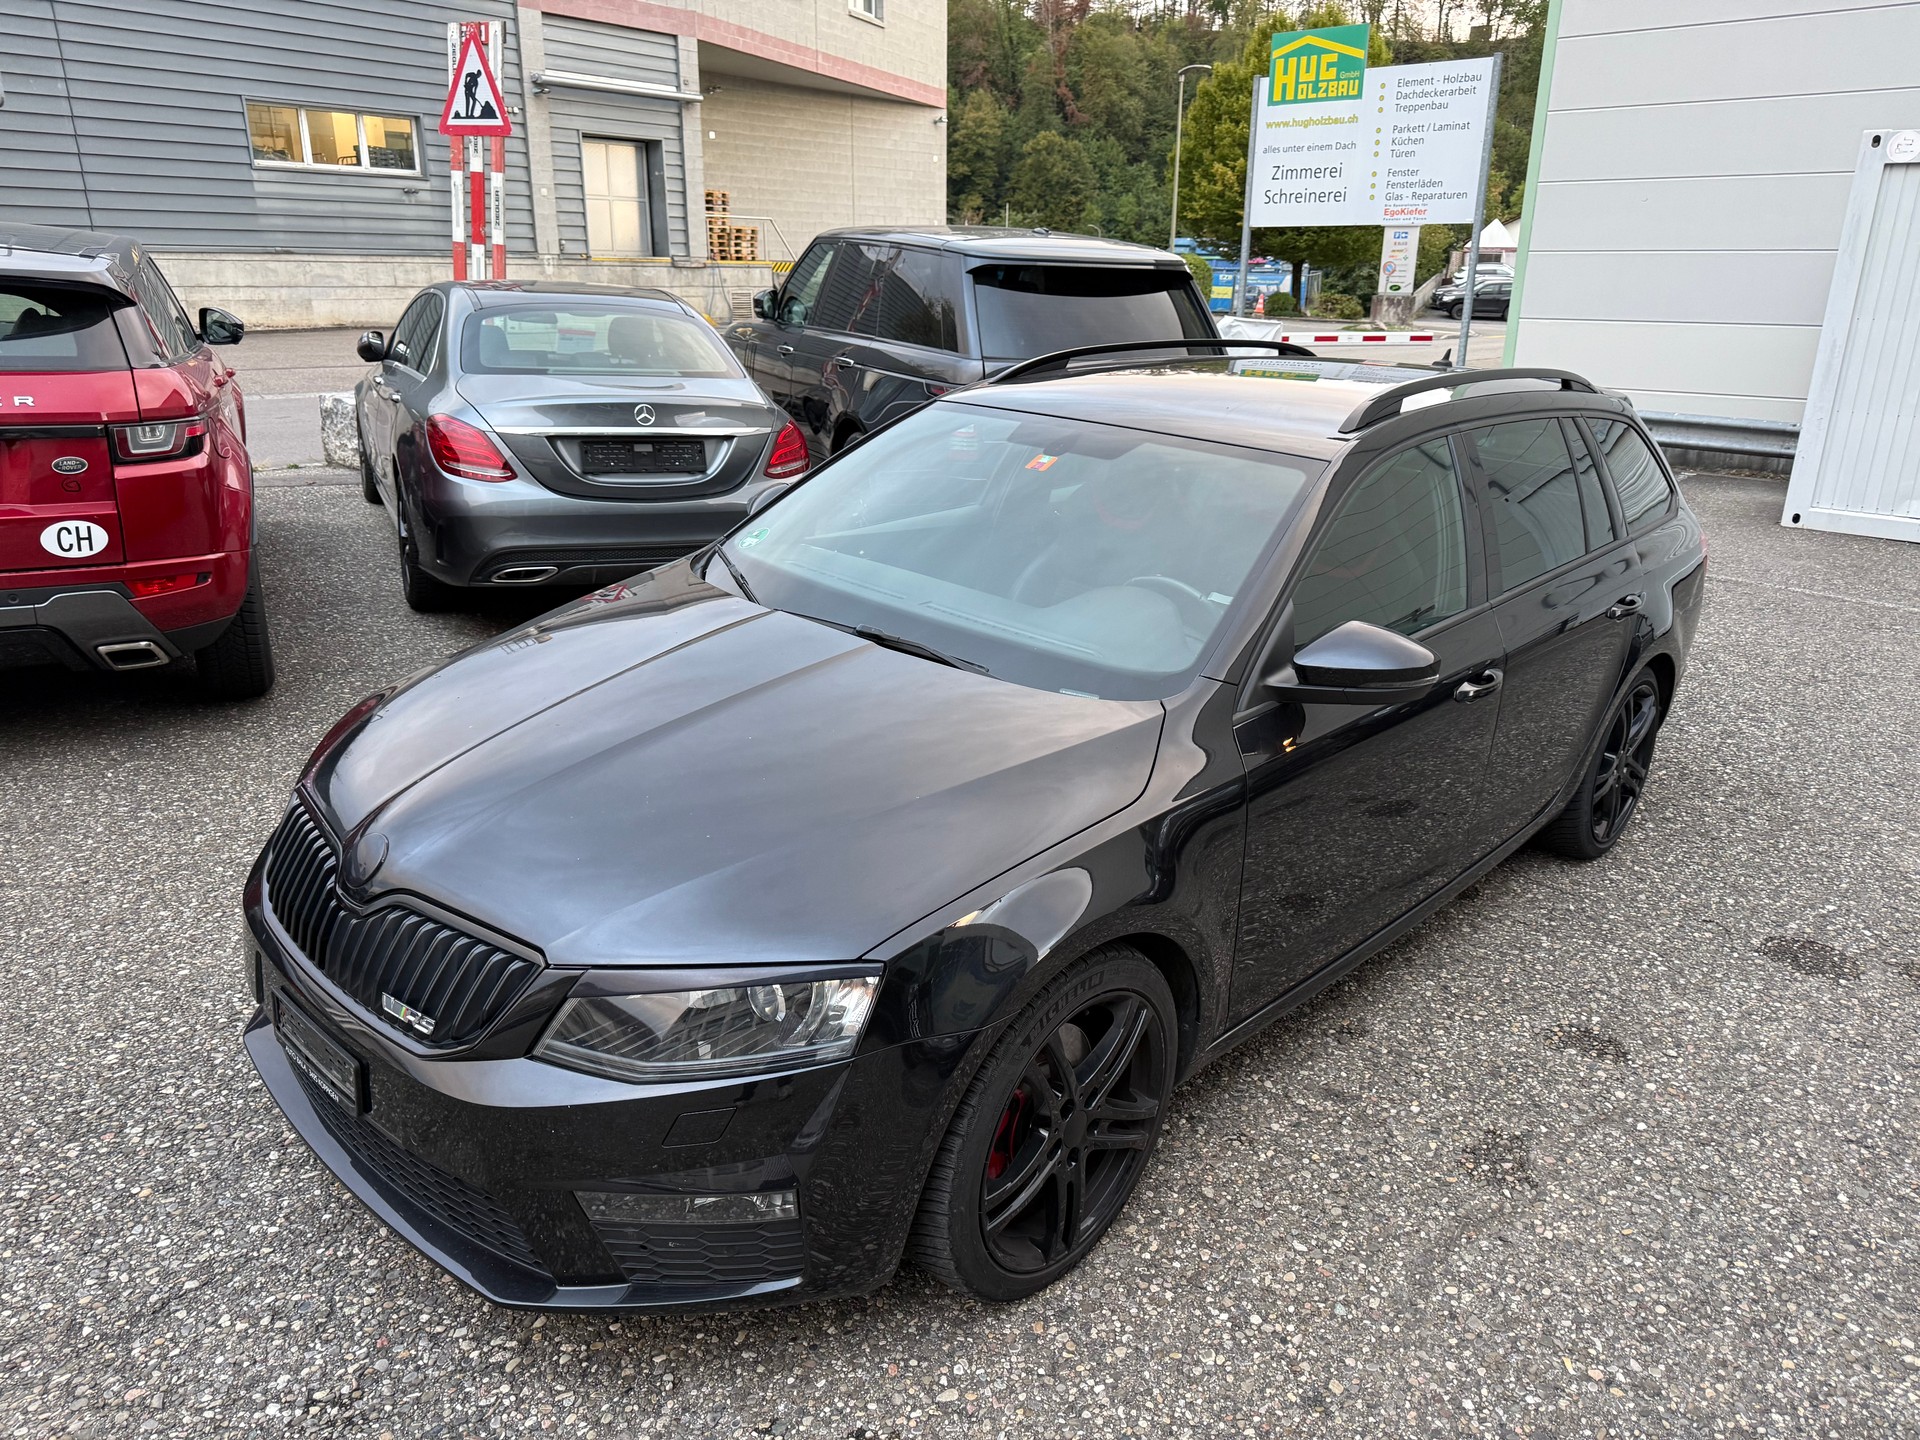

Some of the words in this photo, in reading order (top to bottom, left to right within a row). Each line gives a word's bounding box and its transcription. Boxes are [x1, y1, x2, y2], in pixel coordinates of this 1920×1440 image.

[1273, 53, 1338, 102] HUG
[1340, 71, 1360, 79] GmbH
[1397, 77, 1434, 88] Element
[1443, 73, 1482, 84] Holzbau
[1395, 85, 1477, 100] Dachdeckerarbeit
[1395, 101, 1449, 113] Treppenbau
[1265, 114, 1359, 129] www.hugholzbau.ch
[1392, 124, 1425, 134] Parkett
[1432, 121, 1471, 132] Laminat
[1262, 145, 1281, 154] alles
[1282, 145, 1305, 153] unter
[1306, 143, 1333, 152] einem
[1335, 141, 1357, 150] Dach
[1391, 136, 1424, 146] Küchen
[1390, 149, 1416, 158] Türen
[1271, 162, 1343, 180] Zimmerei
[1387, 168, 1420, 177] Fenster
[1386, 179, 1443, 189] Fensterläden
[1264, 187, 1347, 204] Schreinerei
[1385, 192, 1404, 201] Glas
[1411, 191, 1468, 202] Reparaturen
[1384, 208, 1428, 217] EgoKiefer
[56, 526, 94, 552] CH
[1030, 970, 1104, 1042] MICHELIN
